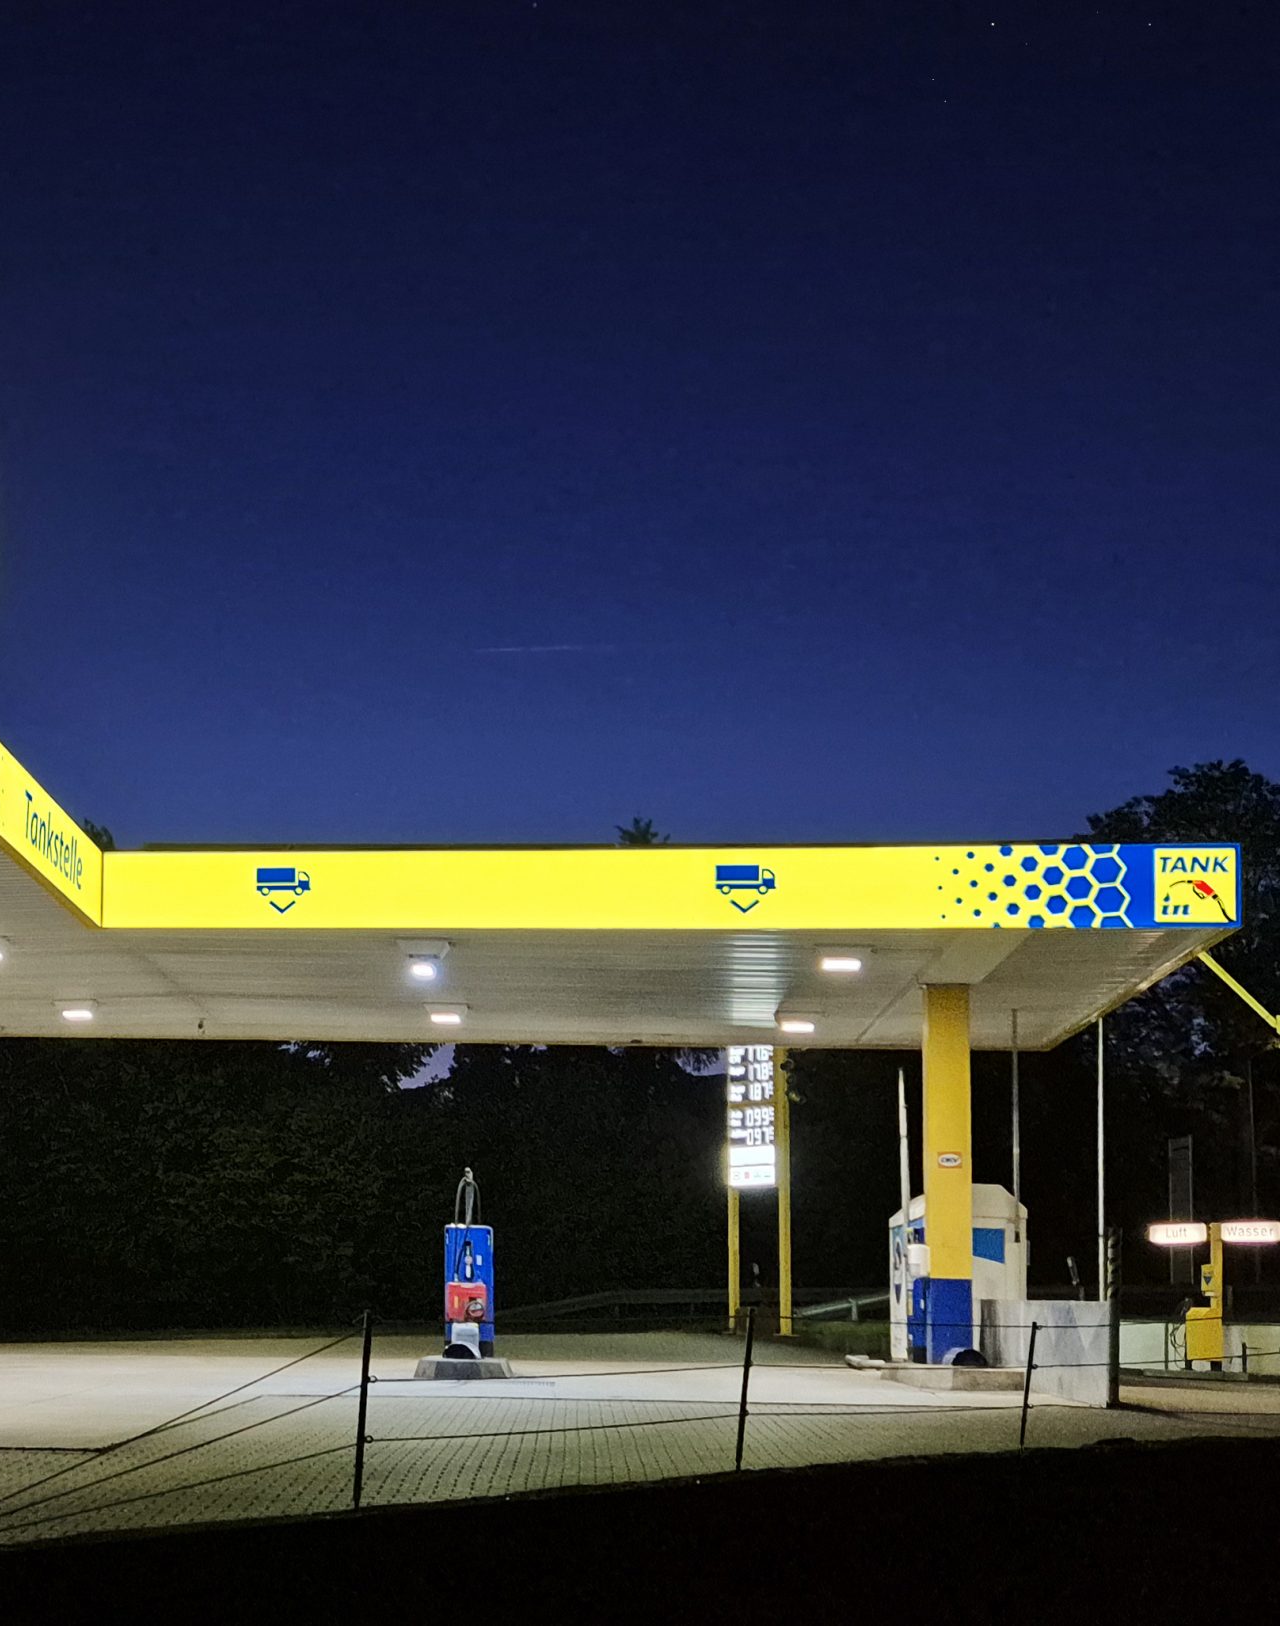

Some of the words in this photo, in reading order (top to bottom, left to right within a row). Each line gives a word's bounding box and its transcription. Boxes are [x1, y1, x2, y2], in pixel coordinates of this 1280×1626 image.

[25, 789, 83, 890] Tankstelle
[1159, 856, 1228, 873] TANK
[1161, 894, 1190, 916] in
[1165, 1227, 1187, 1239] Luft
[1226, 1226, 1273, 1238] Wasser
